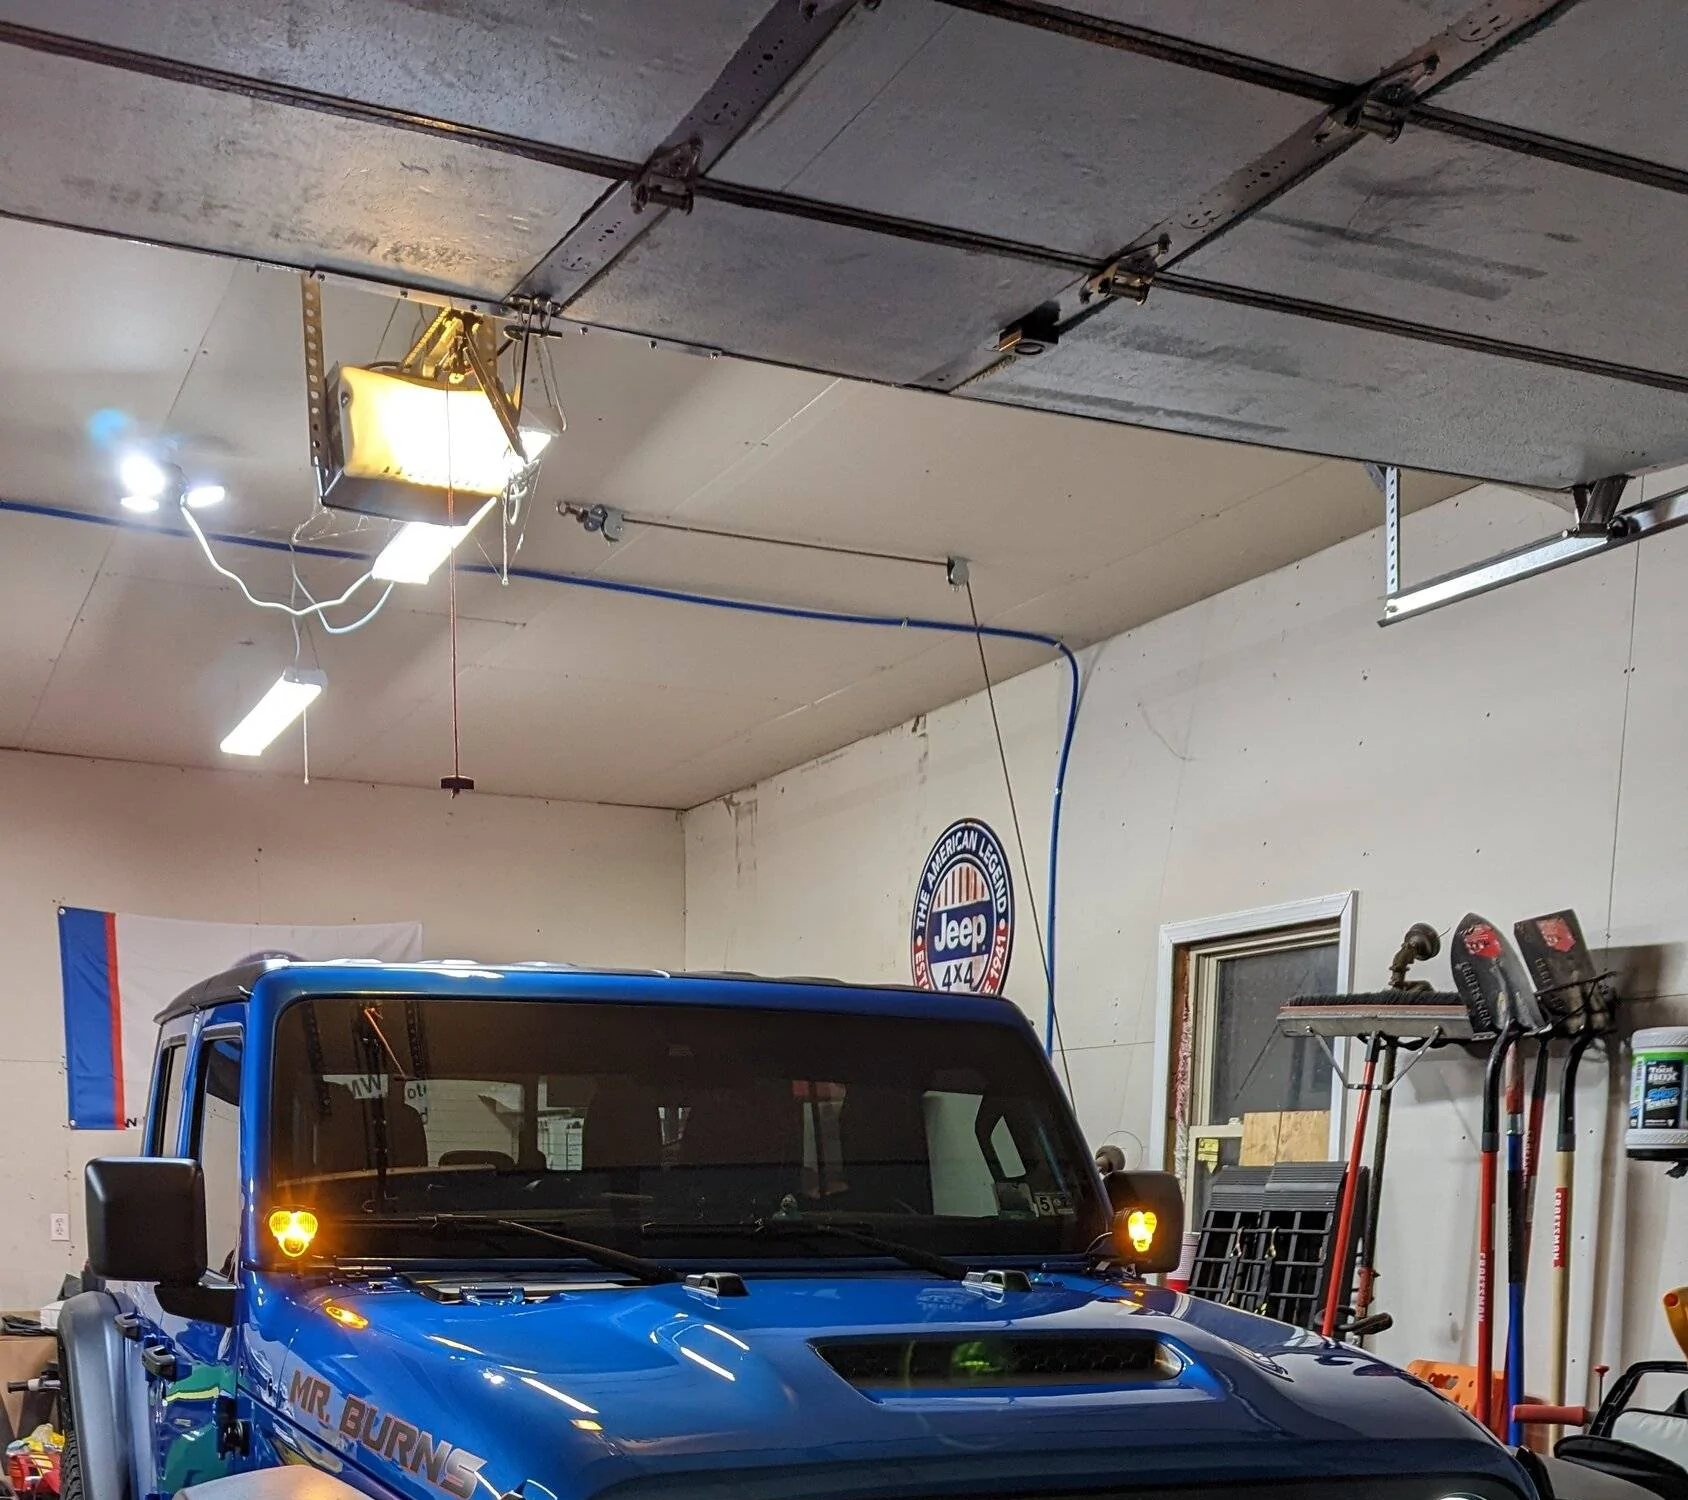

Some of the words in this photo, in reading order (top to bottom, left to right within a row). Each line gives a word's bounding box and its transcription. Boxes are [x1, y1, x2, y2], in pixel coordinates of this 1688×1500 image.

[915, 890, 931, 931] THE
[926, 830, 977, 887] AMERICAN
[979, 837, 1008, 914] LEGEND
[934, 911, 986, 954] Jeep
[989, 935, 1007, 981] 1941
[288, 1368, 332, 1425] MR.
